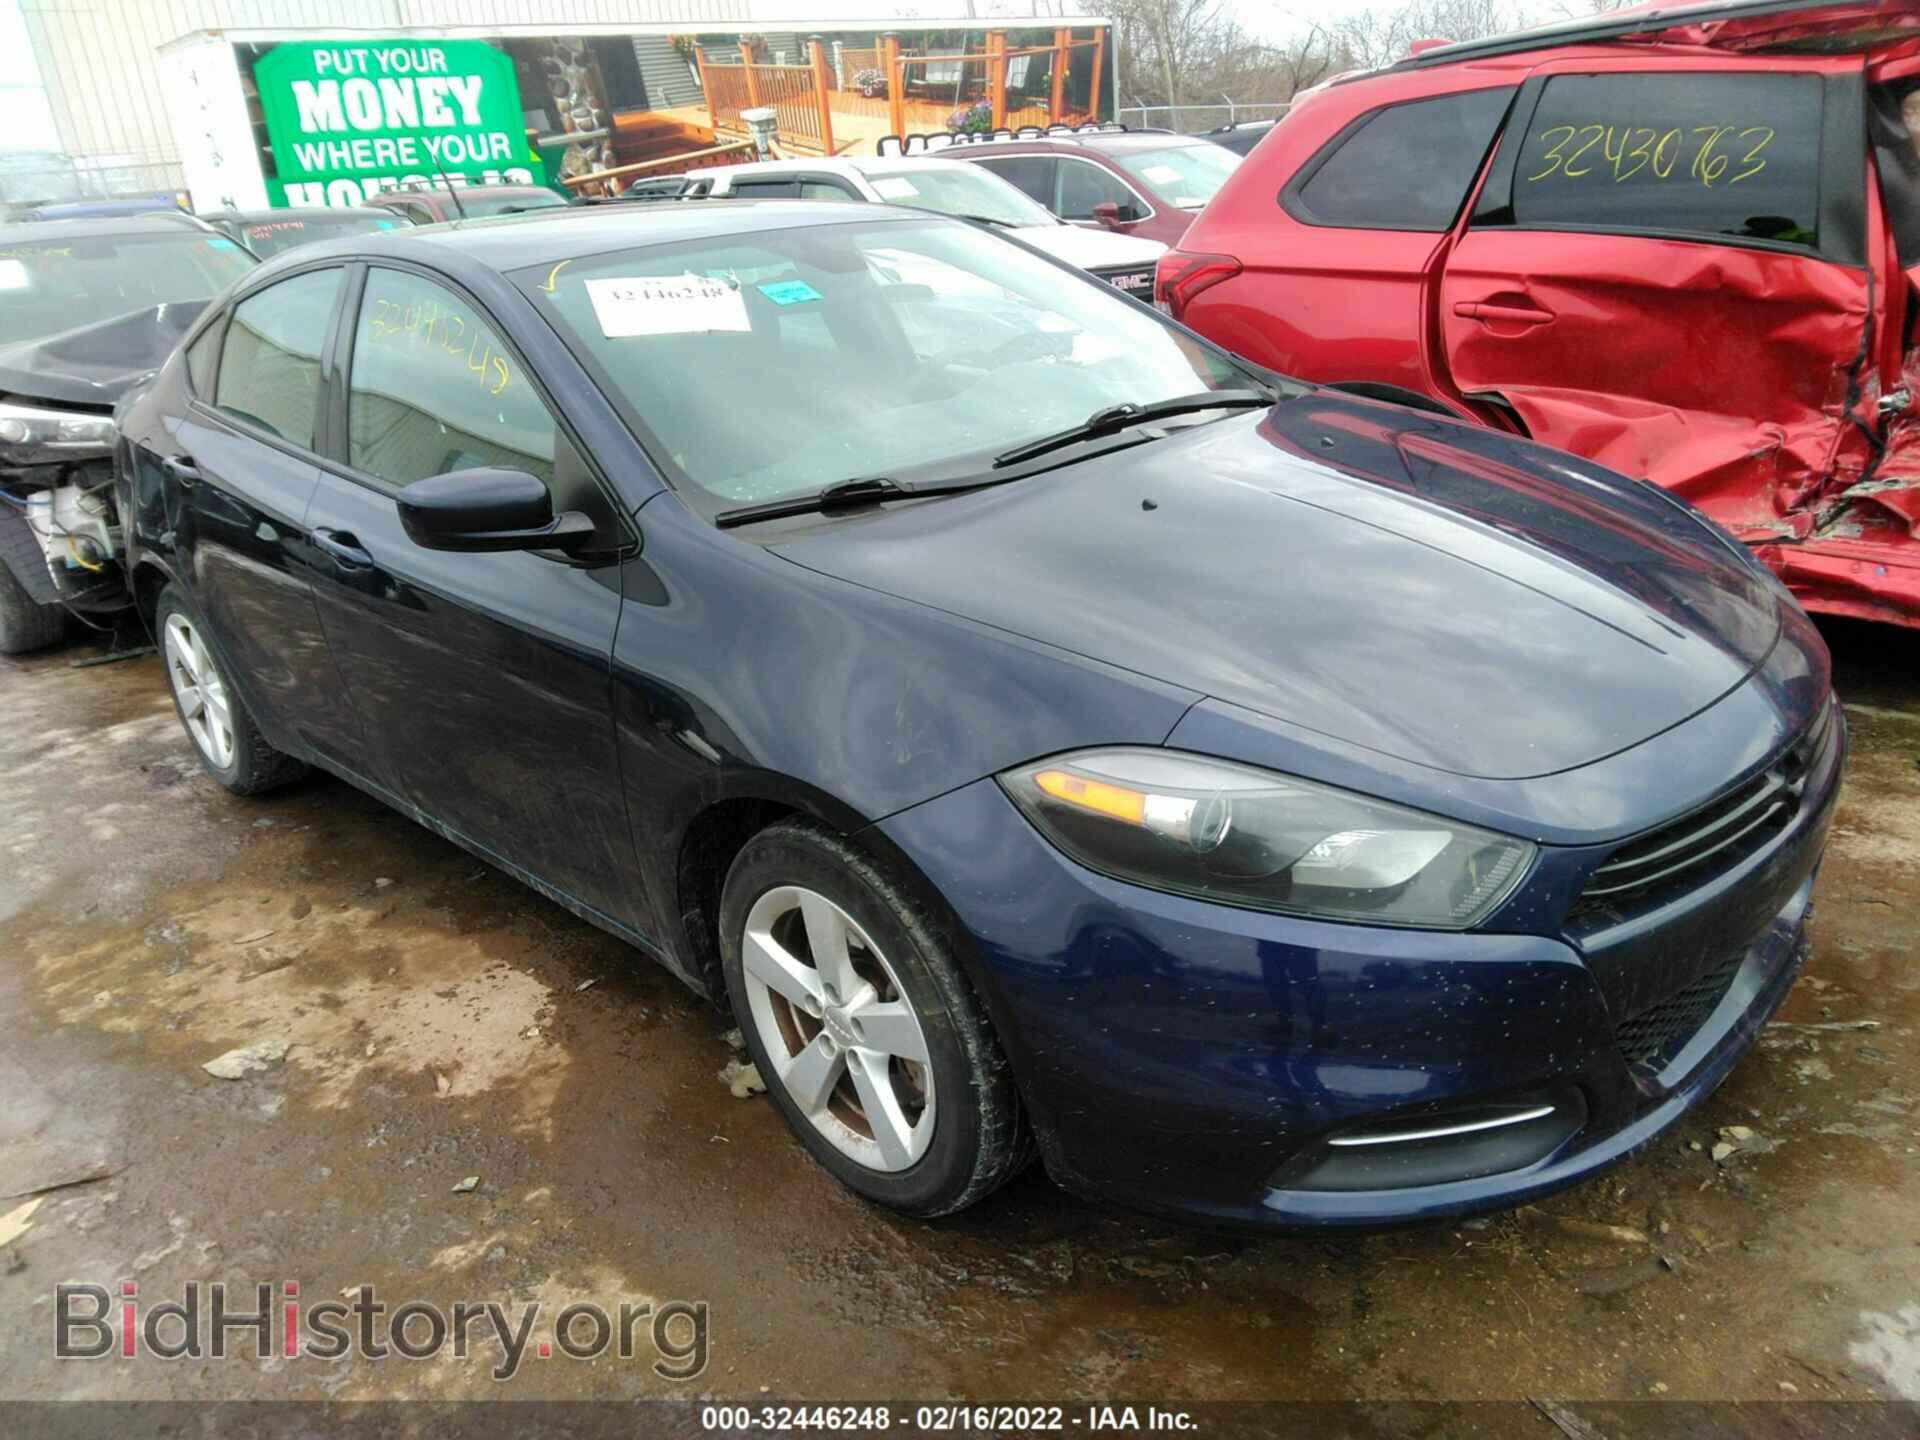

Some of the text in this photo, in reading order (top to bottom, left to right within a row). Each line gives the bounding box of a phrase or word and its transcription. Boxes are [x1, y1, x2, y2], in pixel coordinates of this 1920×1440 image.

[313, 48, 448, 75] PUT YOUR
[291, 75, 483, 133] MONEY
[293, 132, 513, 172] WHERE YOUR
[1528, 124, 1775, 188] 32430763
[1111, 273, 1150, 289] GMC
